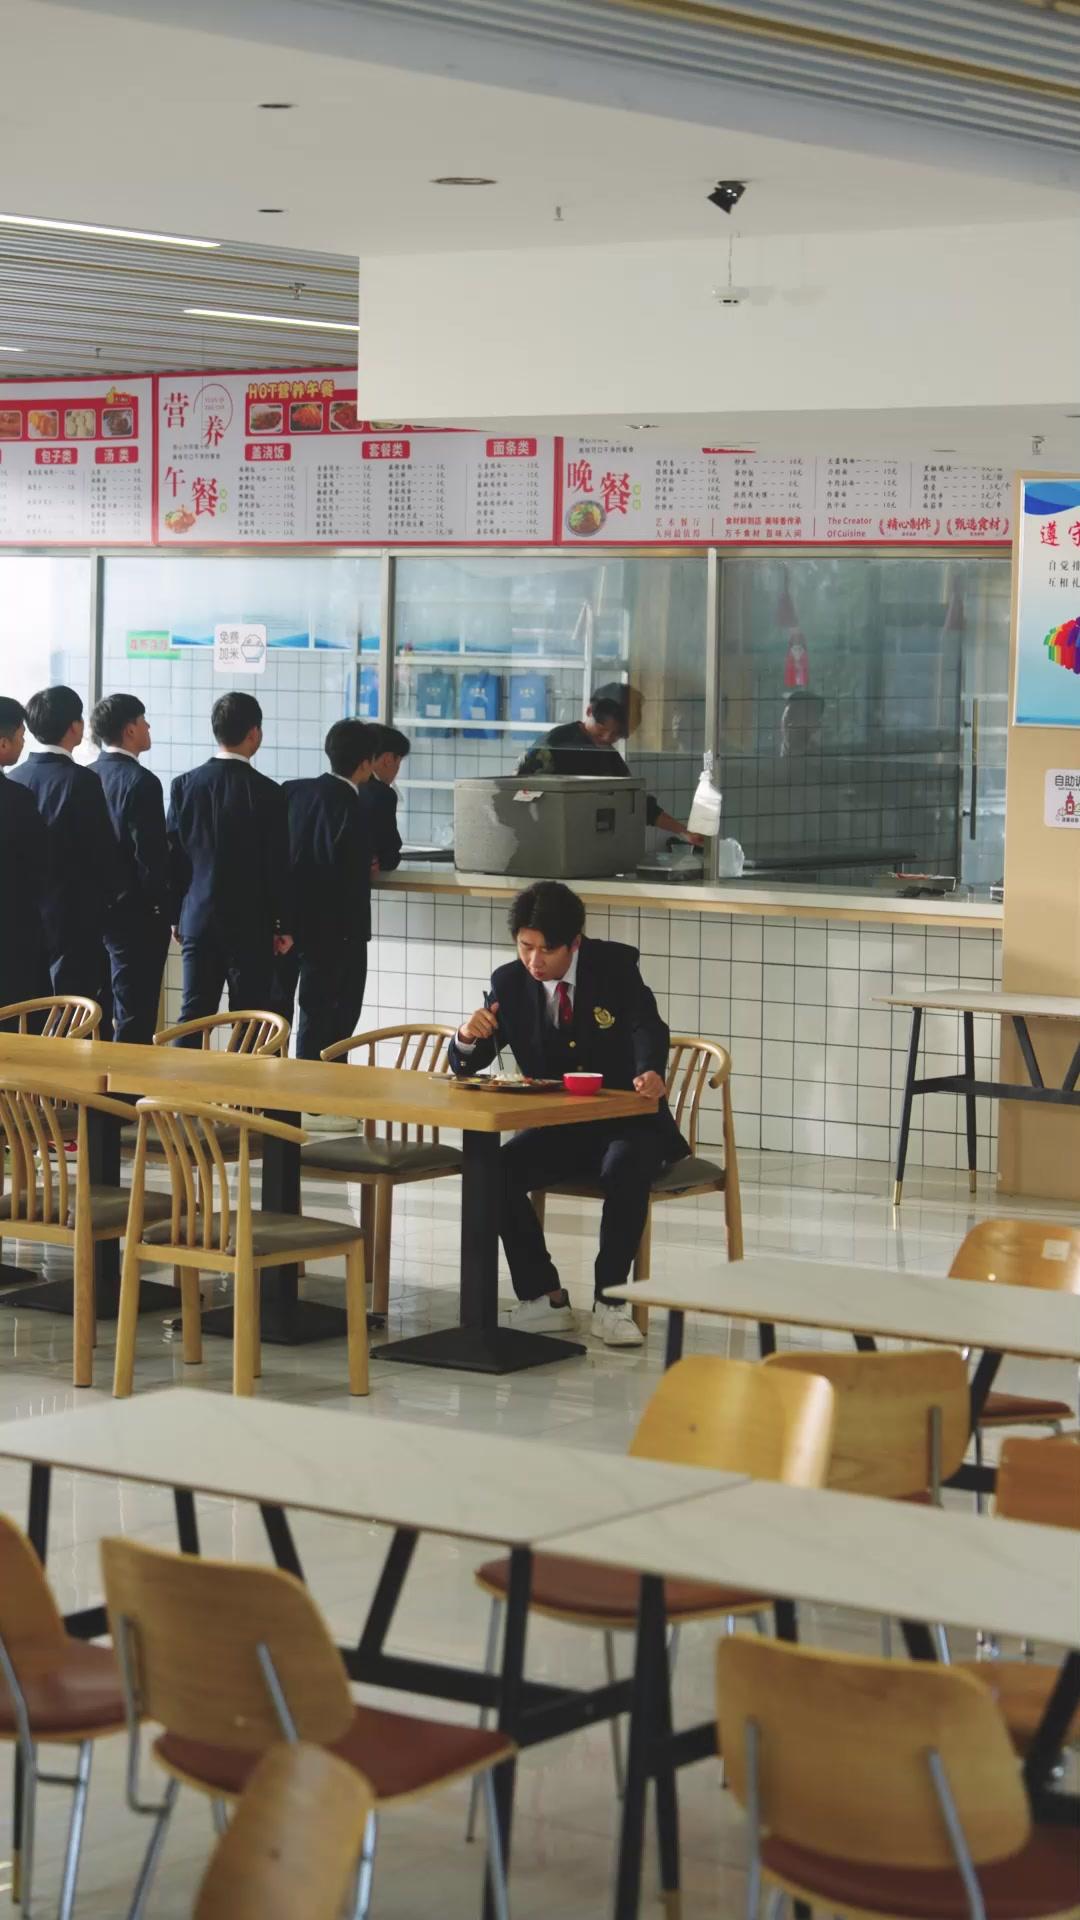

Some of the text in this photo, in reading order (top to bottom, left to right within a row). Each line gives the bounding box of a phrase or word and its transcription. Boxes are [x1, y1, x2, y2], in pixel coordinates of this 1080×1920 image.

[251, 445, 285, 460] 盖浇饭
[368, 442, 404, 458] 套餐类
[492, 440, 530, 456] 面条类
[41, 449, 72, 464] 包子类
[828, 517, 872, 525] The Creator
[887, 517, 931, 531] 精心制作
[955, 517, 1000, 531] 甄选食材
[219, 631, 239, 644] 免费
[219, 647, 239, 660] 加米
